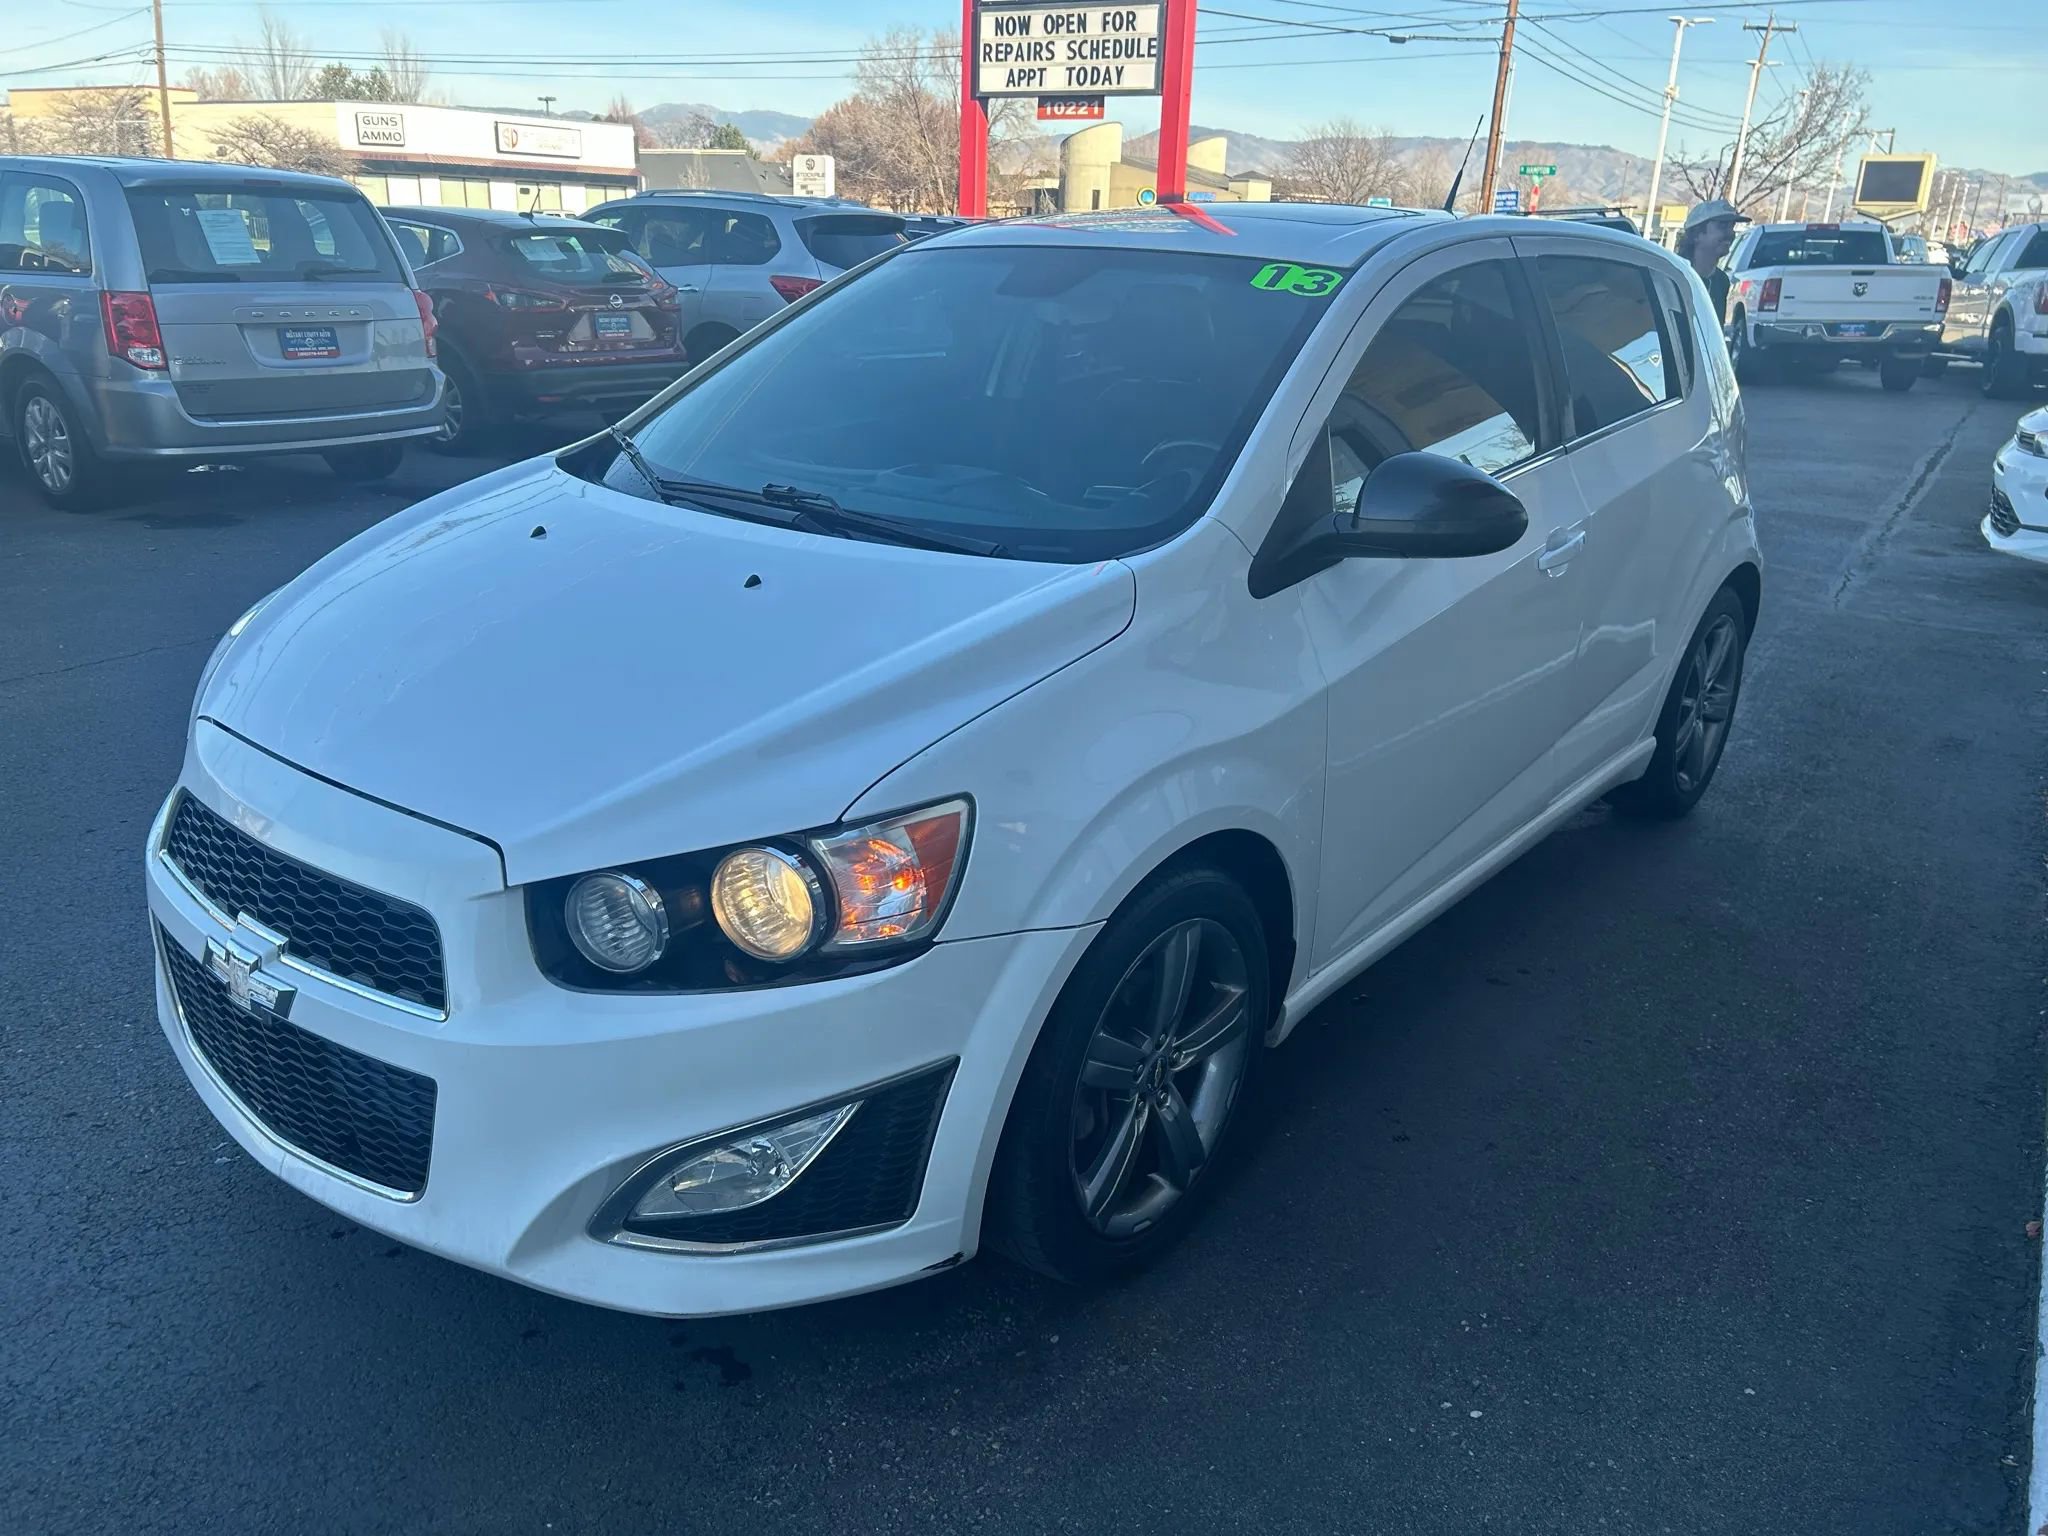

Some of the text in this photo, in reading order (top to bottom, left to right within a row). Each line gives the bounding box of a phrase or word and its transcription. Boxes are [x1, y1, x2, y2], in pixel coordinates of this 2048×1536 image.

[994, 11, 1137, 36] NOW OPEN FOR
[982, 38, 1157, 63] REPAIRS SCHEDULE
[1006, 66, 1125, 88] APPT TODAY
[1044, 100, 1100, 116] 10221
[362, 115, 398, 127] GUNS
[361, 130, 402, 142] AMMO
[1262, 265, 1336, 294] 13
